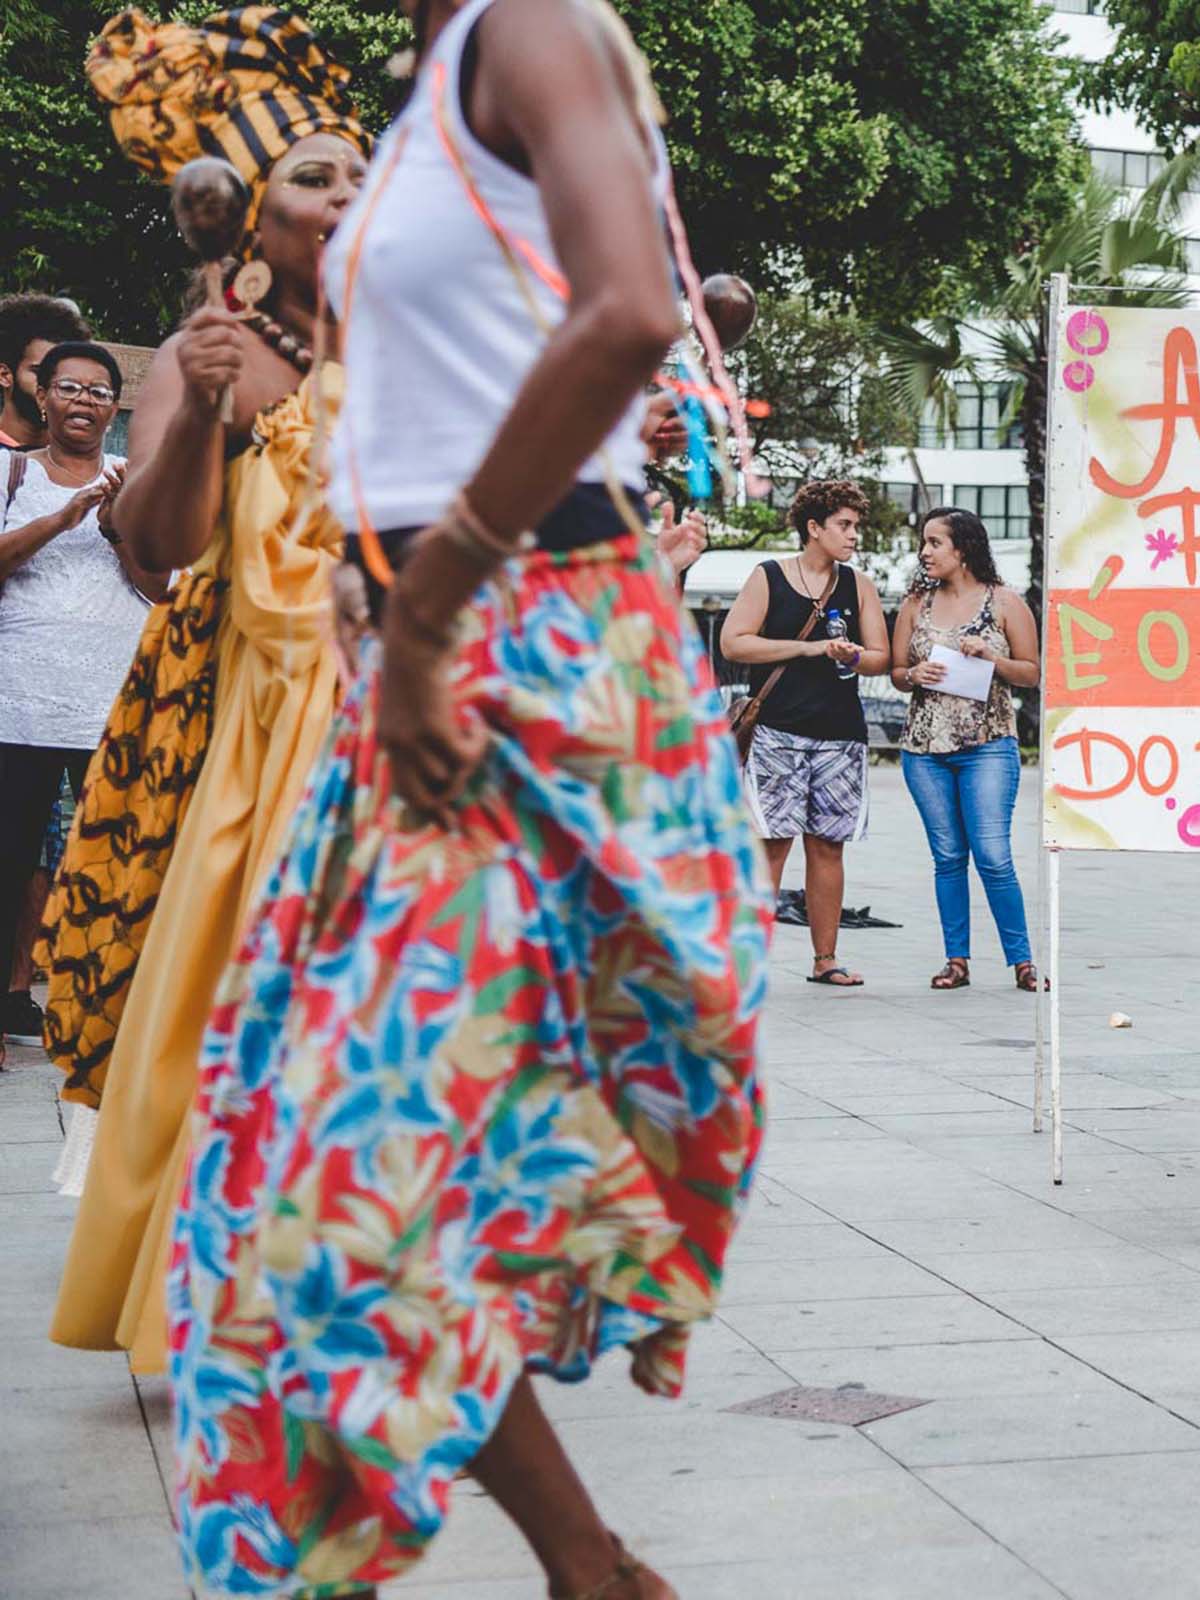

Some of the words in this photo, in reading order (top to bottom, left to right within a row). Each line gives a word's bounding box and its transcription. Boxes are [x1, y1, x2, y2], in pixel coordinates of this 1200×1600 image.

[1058, 555, 1125, 690] É
[1137, 611, 1190, 681] O
[1053, 727, 1180, 801] DO
